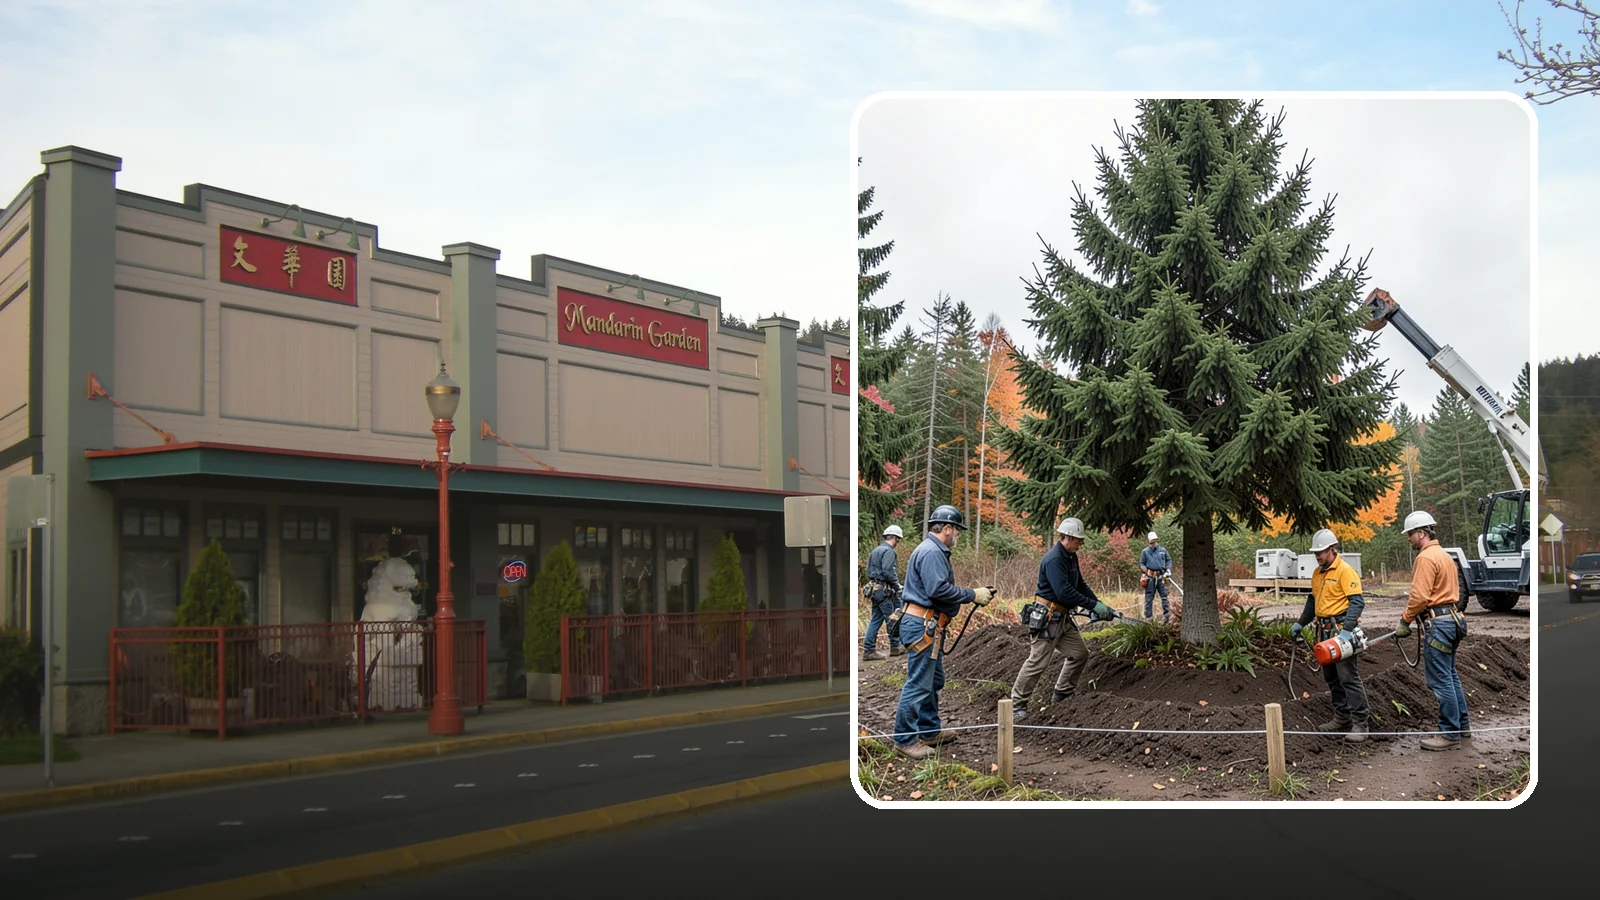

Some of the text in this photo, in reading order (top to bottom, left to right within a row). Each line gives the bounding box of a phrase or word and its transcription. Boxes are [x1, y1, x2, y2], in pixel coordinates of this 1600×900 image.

[230, 235, 346, 291] 文華園
[564, 302, 701, 352] Mandarin Garden
[503, 565, 527, 578] OPEN
